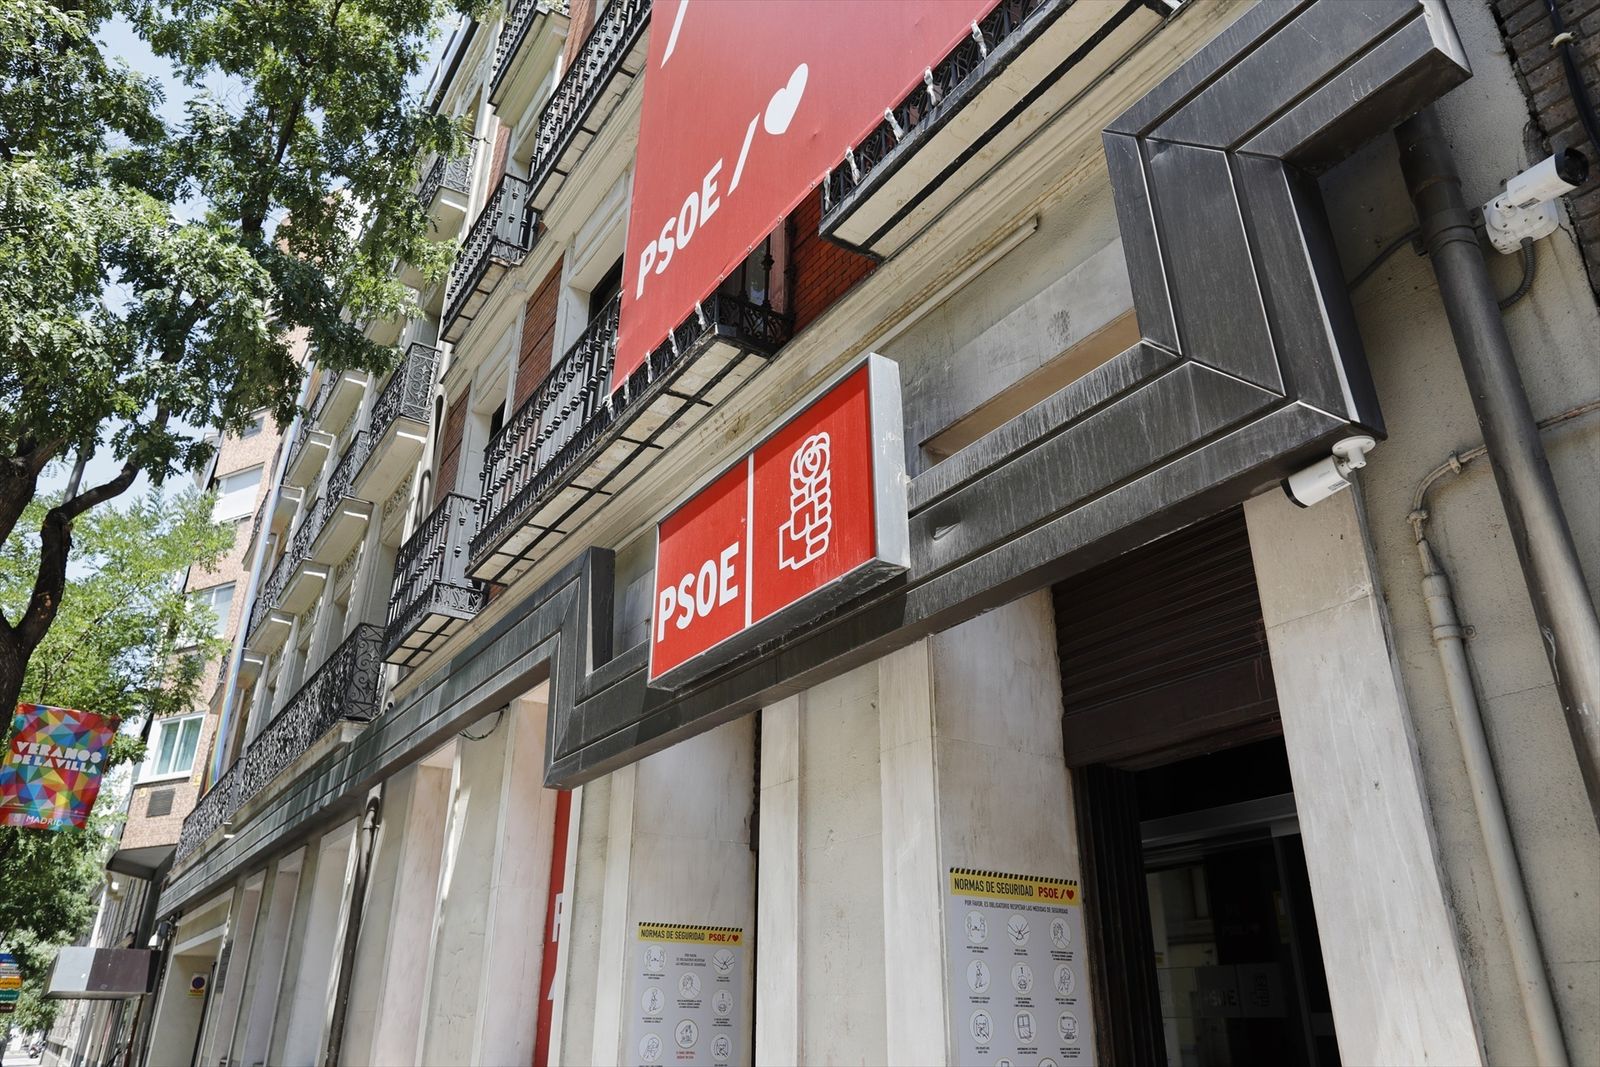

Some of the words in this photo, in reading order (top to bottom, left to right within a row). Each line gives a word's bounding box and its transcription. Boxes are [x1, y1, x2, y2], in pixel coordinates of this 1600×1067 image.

[636, 157, 723, 300] PSOE
[657, 541, 739, 643] PSOE
[16, 741, 102, 764] VERANOS
[26, 815, 64, 827] MADRID
[954, 878, 984, 892] NORMAS
[986, 882, 995, 894] DE
[996, 882, 1034, 897] SEGURIDAD
[1038, 886, 1059, 899] PSOE
[640, 929, 665, 939] NORMAS
[666, 930, 674, 940] DE
[674, 931, 706, 941] SEGURIDAD
[708, 933, 726, 942] PSOE
